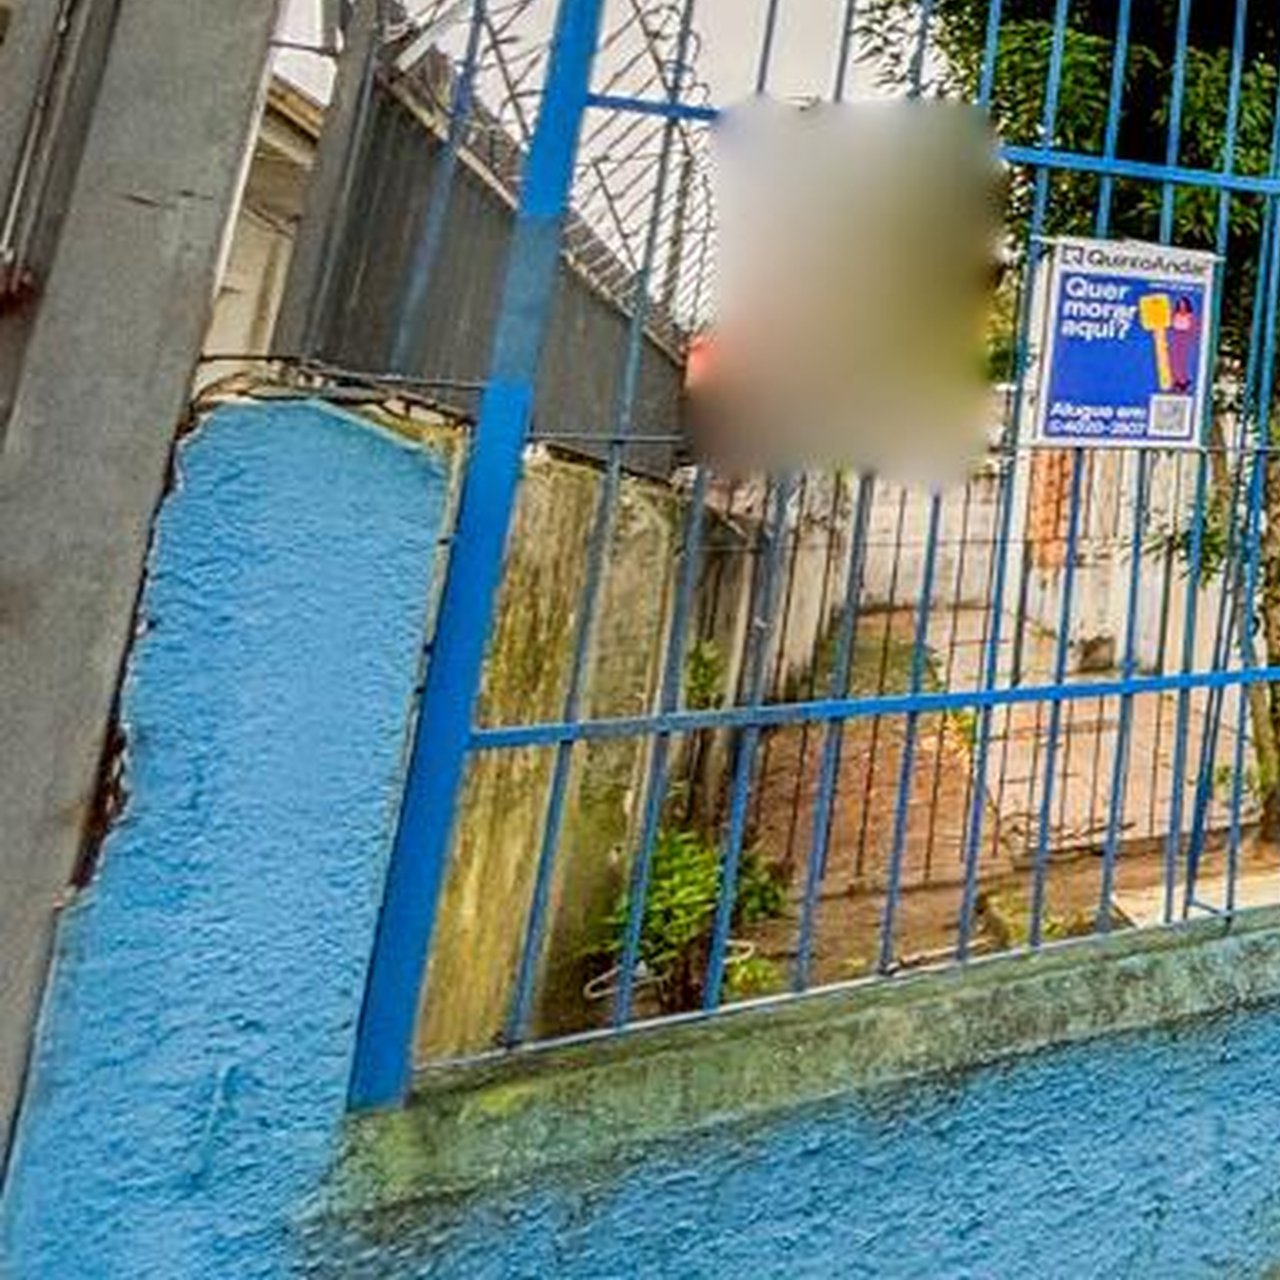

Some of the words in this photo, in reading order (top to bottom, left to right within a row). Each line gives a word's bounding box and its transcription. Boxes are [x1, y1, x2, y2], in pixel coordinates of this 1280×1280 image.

[1066, 276, 1132, 301] Quer
[1062, 300, 1137, 320] morar
[1061, 319, 1130, 341] aqui?
[1049, 402, 1114, 421] Alugue
